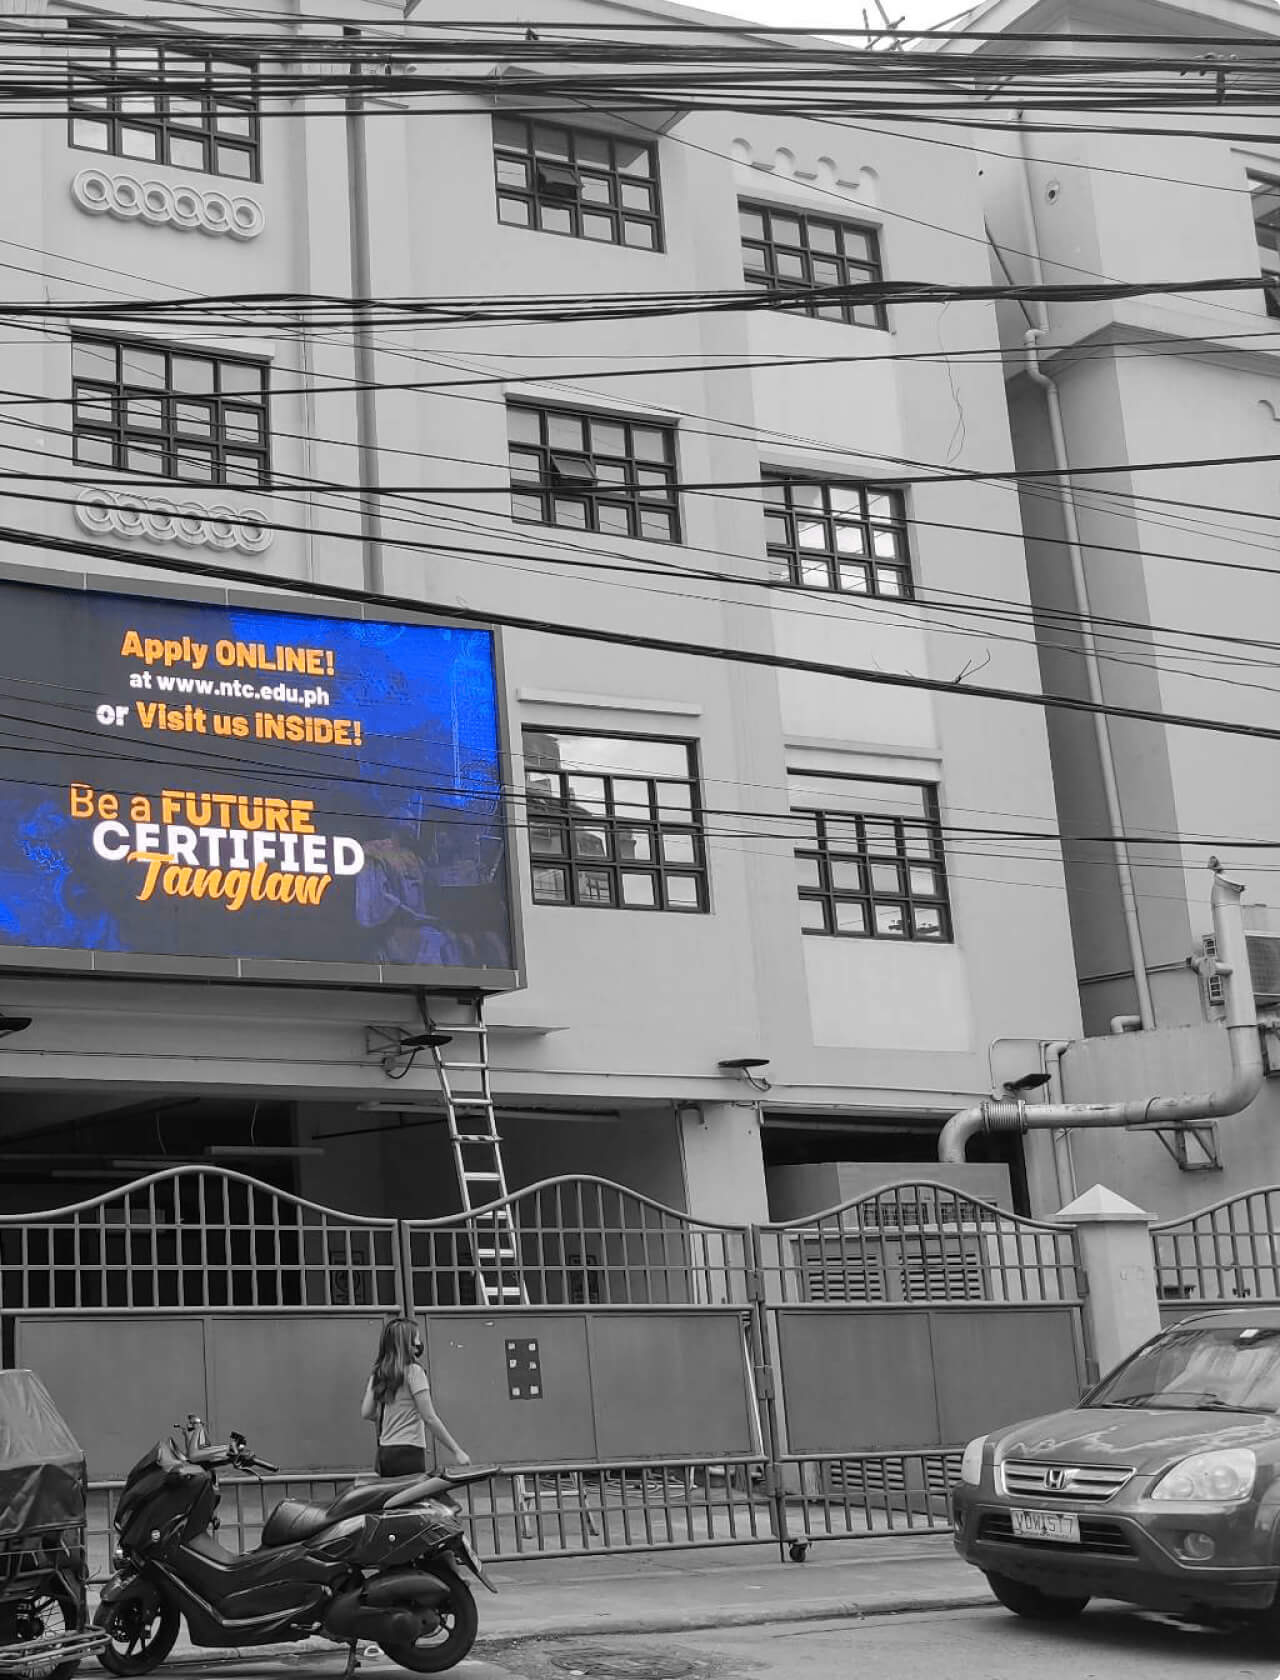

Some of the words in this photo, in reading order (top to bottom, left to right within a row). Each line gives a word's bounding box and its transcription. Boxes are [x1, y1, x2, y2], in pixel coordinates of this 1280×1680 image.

[121, 629, 209, 670] Apply
[215, 638, 336, 677] ONLINE!
[129, 670, 152, 691] at
[156, 675, 331, 709] www.ntc.edu.ph
[95, 703, 130, 727] or
[135, 700, 207, 735] Visit
[213, 713, 250, 737] us
[254, 711, 363, 747] INSIDE!
[68, 782, 119, 820] Be
[130, 794, 152, 822] a
[160, 789, 316, 835] FUTURE
[92, 819, 366, 877] CERTIFIED
[126, 850, 333, 912] Tanglaw
